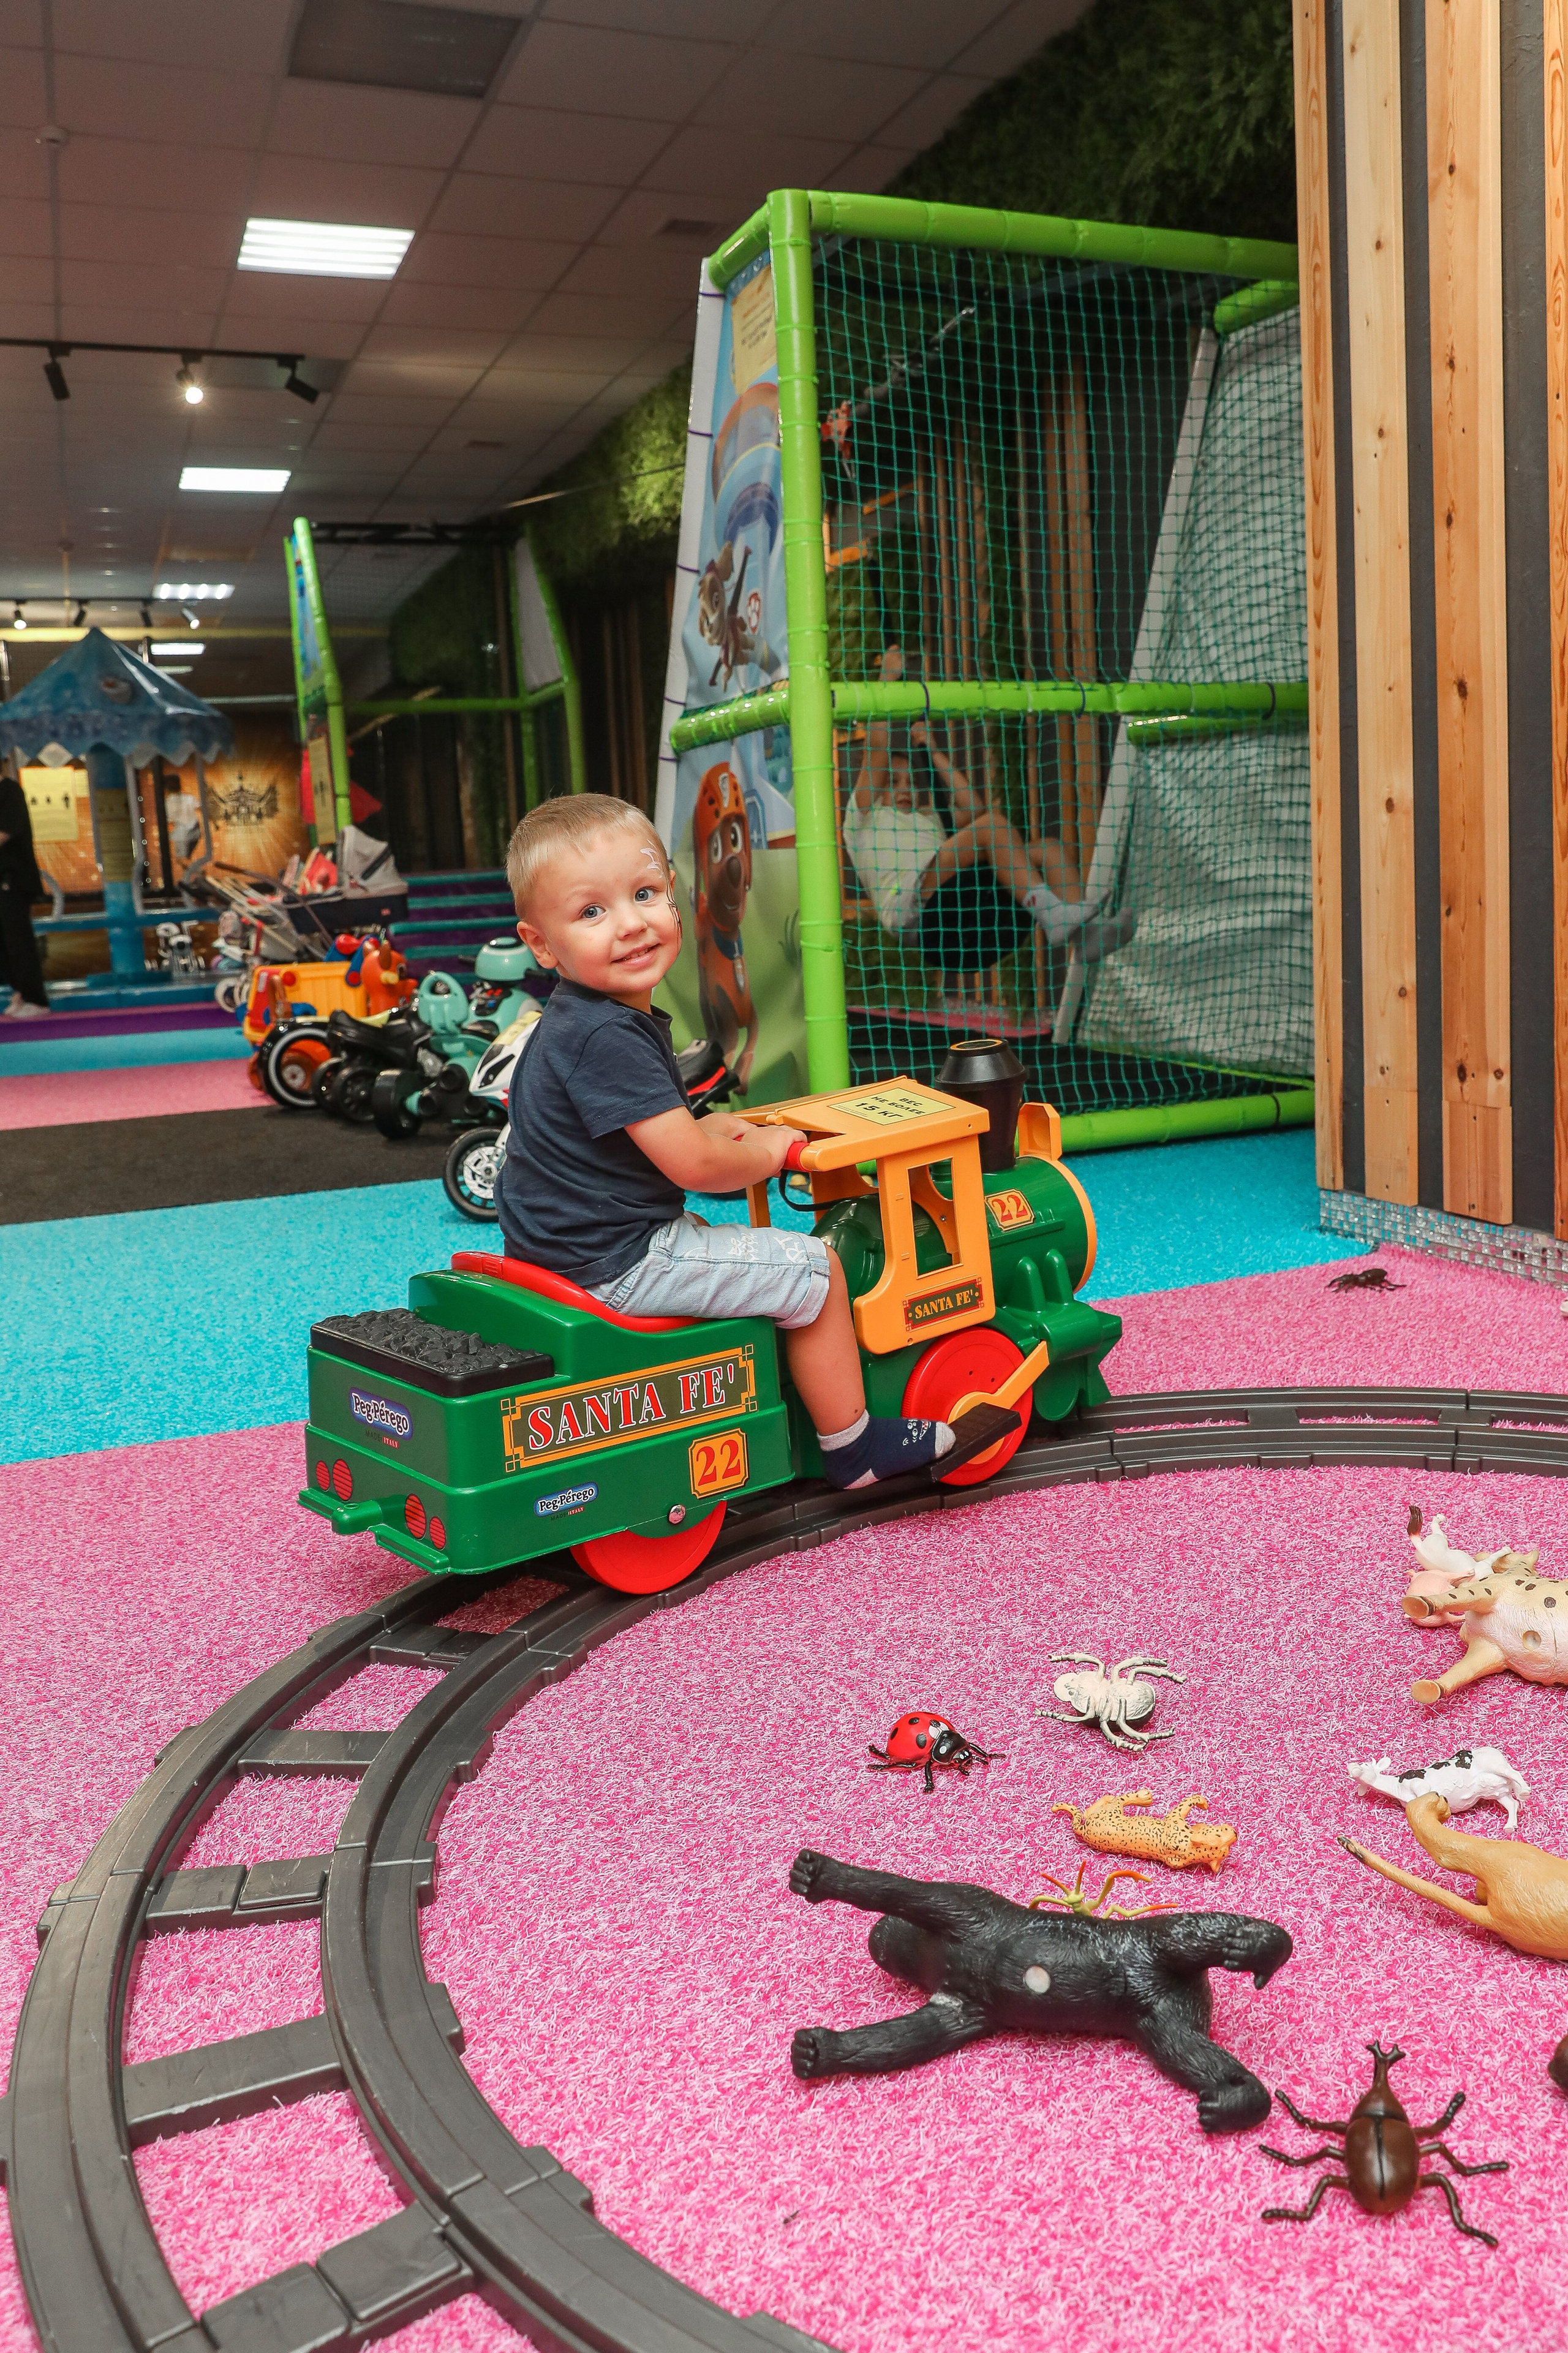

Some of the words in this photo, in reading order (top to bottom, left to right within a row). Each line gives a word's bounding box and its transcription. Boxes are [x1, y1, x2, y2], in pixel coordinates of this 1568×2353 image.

[855, 1103, 880, 1111] 15
[888, 1102, 925, 1115] БОЛЕЕ
[899, 1098, 923, 1106] ВЕС
[991, 1194, 1028, 1223] 22
[914, 1296, 954, 1319] SANTA
[528, 1382, 666, 1450] SANTA
[383, 1437, 399, 1448] ITALY
[696, 1439, 741, 1487] 22
[569, 1507, 584, 1516] ITALY
